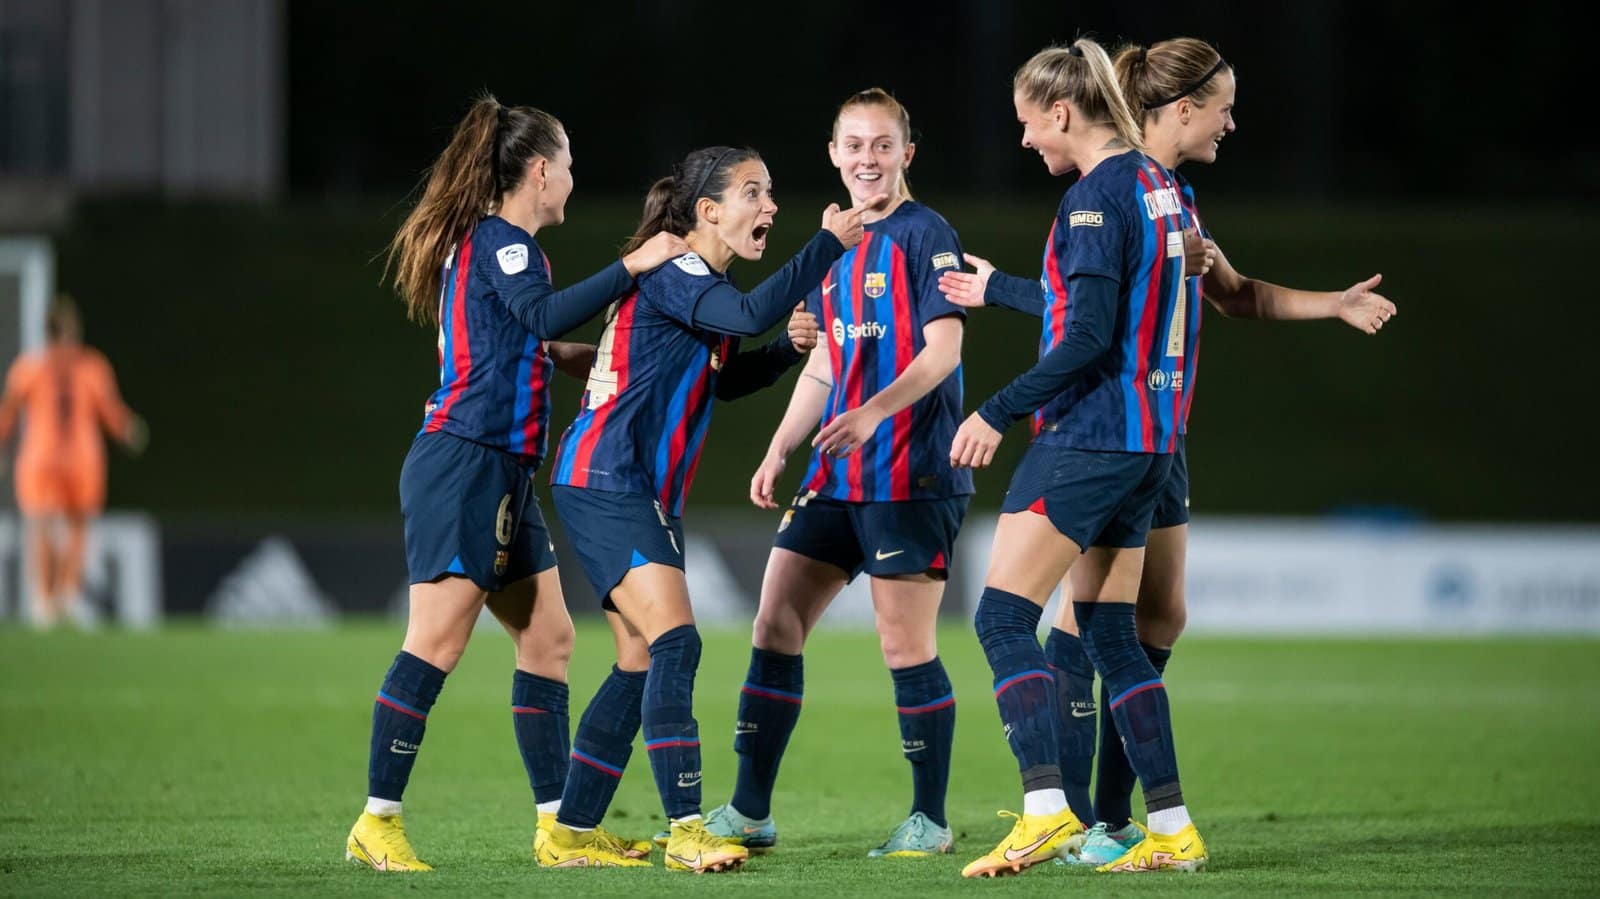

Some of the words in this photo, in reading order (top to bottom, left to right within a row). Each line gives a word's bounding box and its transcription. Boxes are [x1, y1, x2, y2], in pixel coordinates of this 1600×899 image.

[1070, 212, 1103, 225] BIMBO
[847, 322, 887, 340] Spotify
[495, 494, 513, 545] 6
